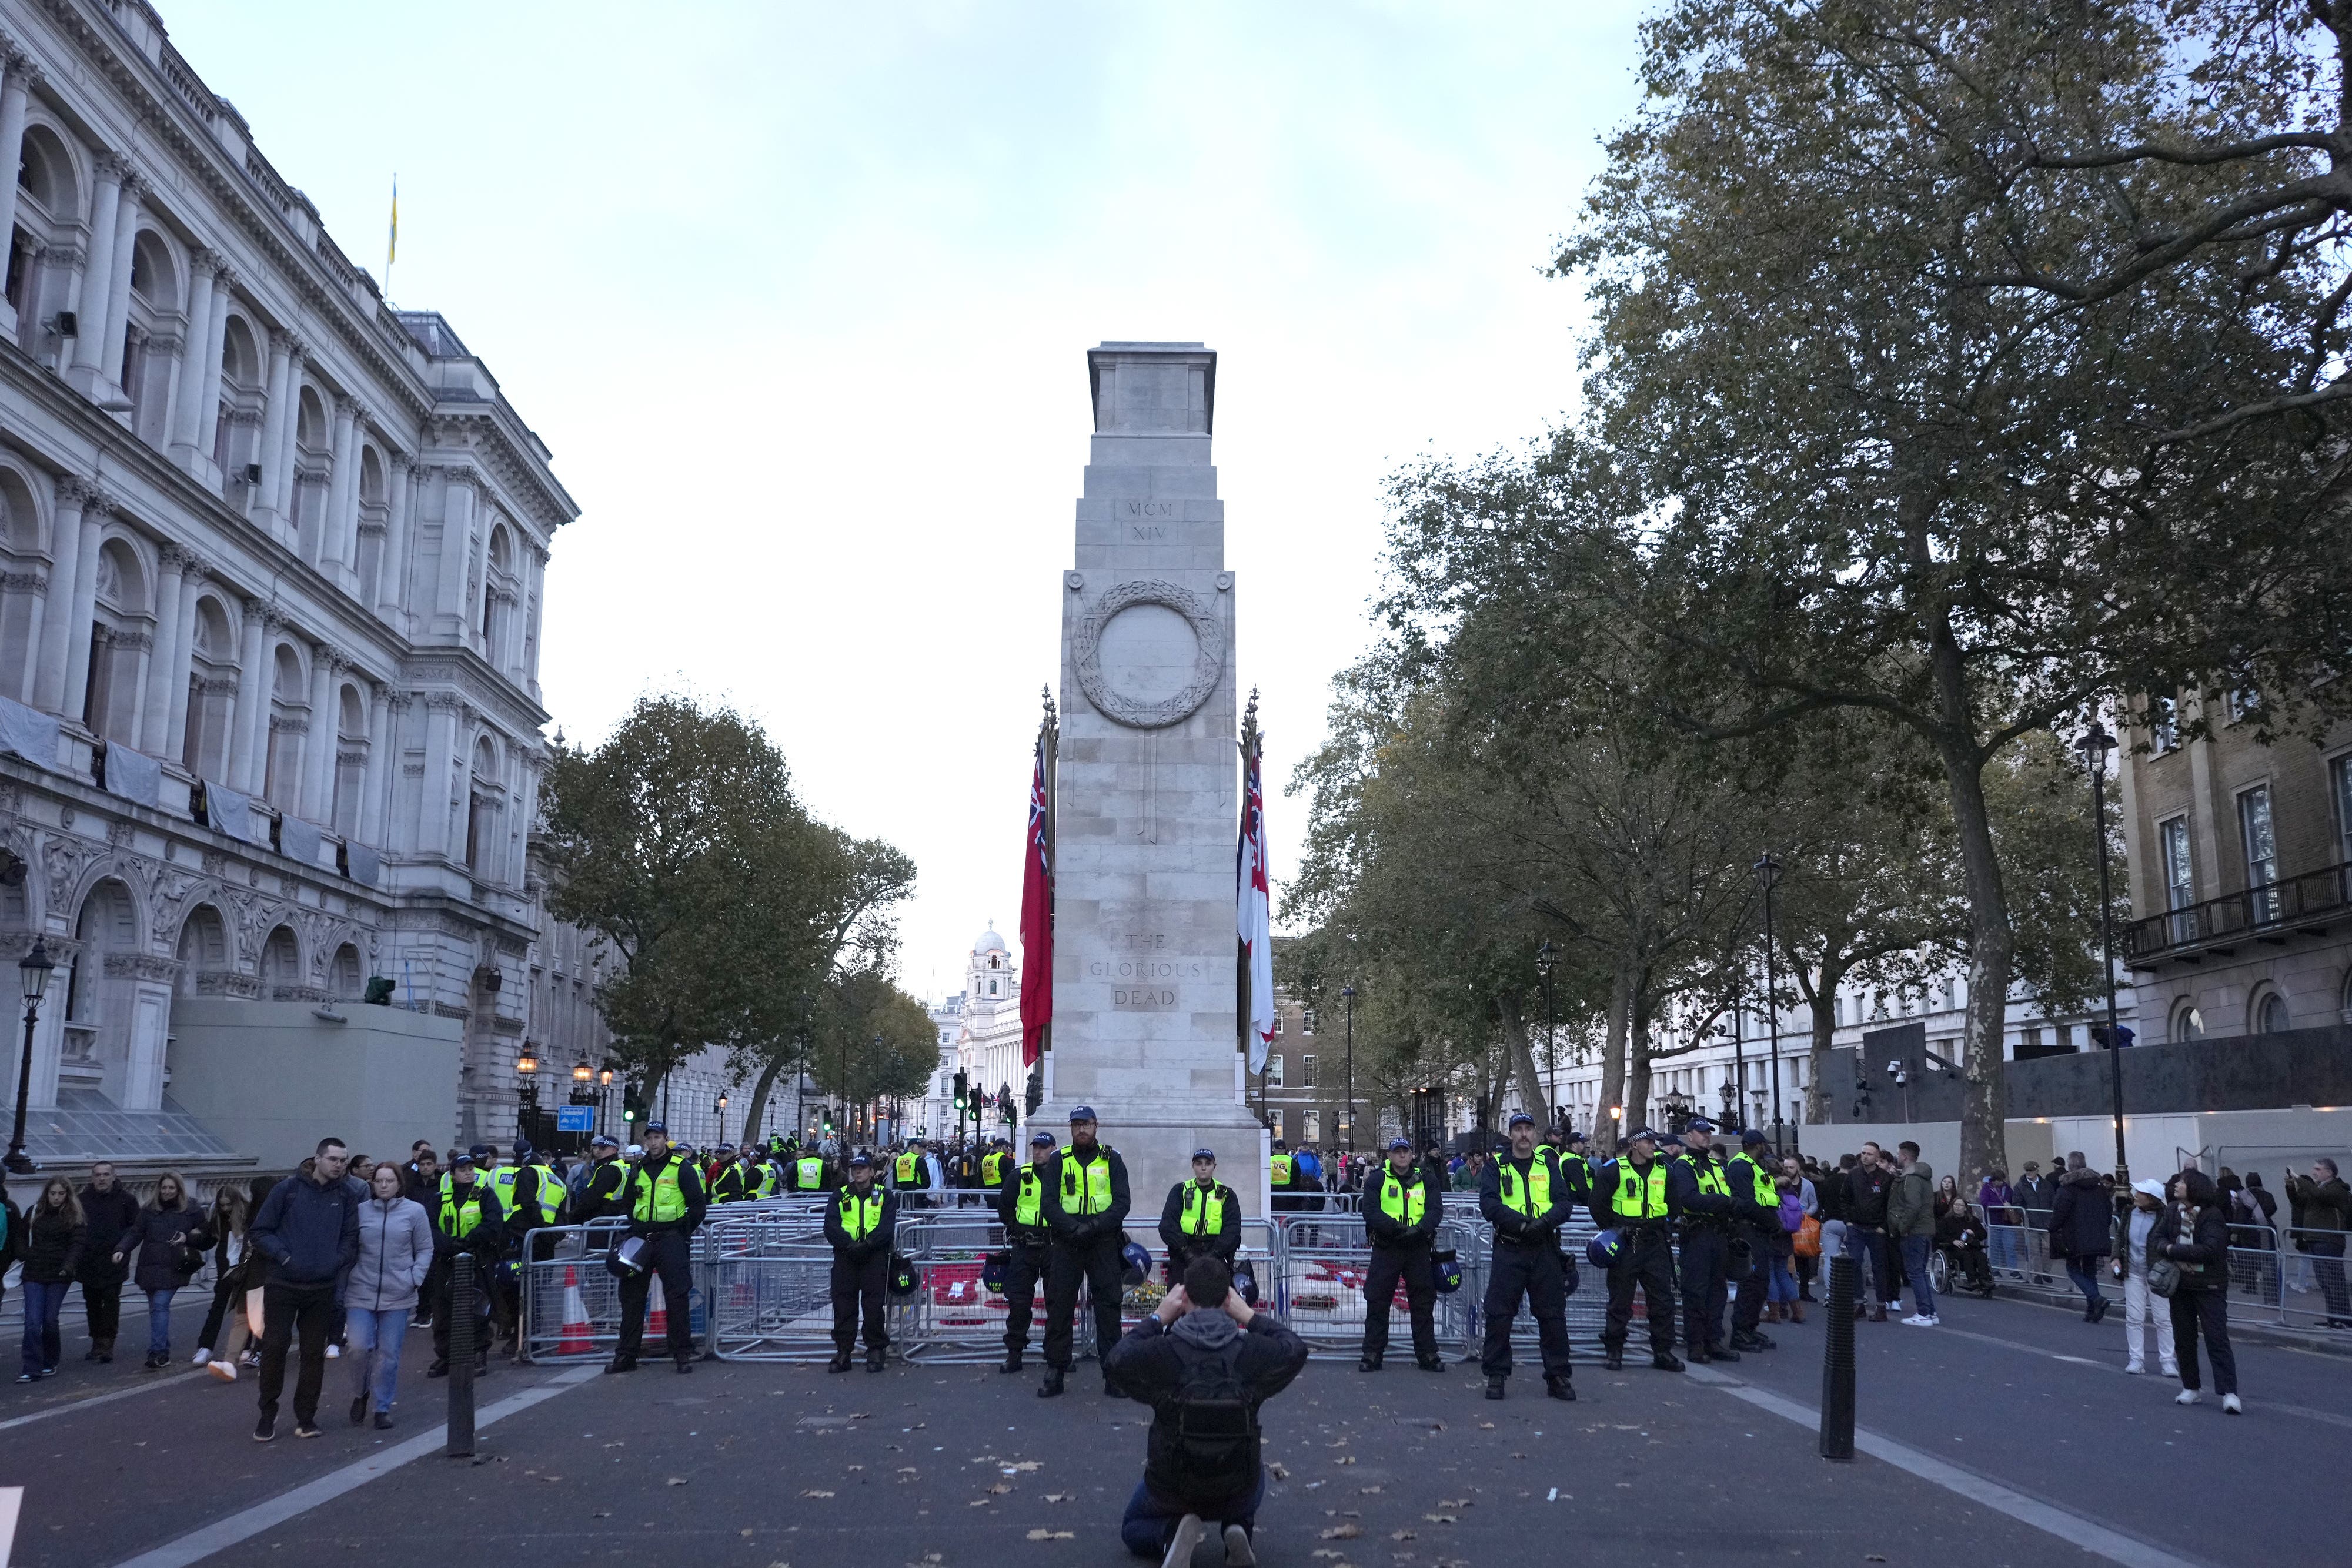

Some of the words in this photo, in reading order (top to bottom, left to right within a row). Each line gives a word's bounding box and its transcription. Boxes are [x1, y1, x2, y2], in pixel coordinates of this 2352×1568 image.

[1129, 503, 1171, 516] MCM
[1133, 527, 1167, 540] XIV
[1125, 934, 1165, 949] THE
[1090, 962, 1201, 978] GLORIOUS
[1114, 990, 1175, 1005] DEAD
